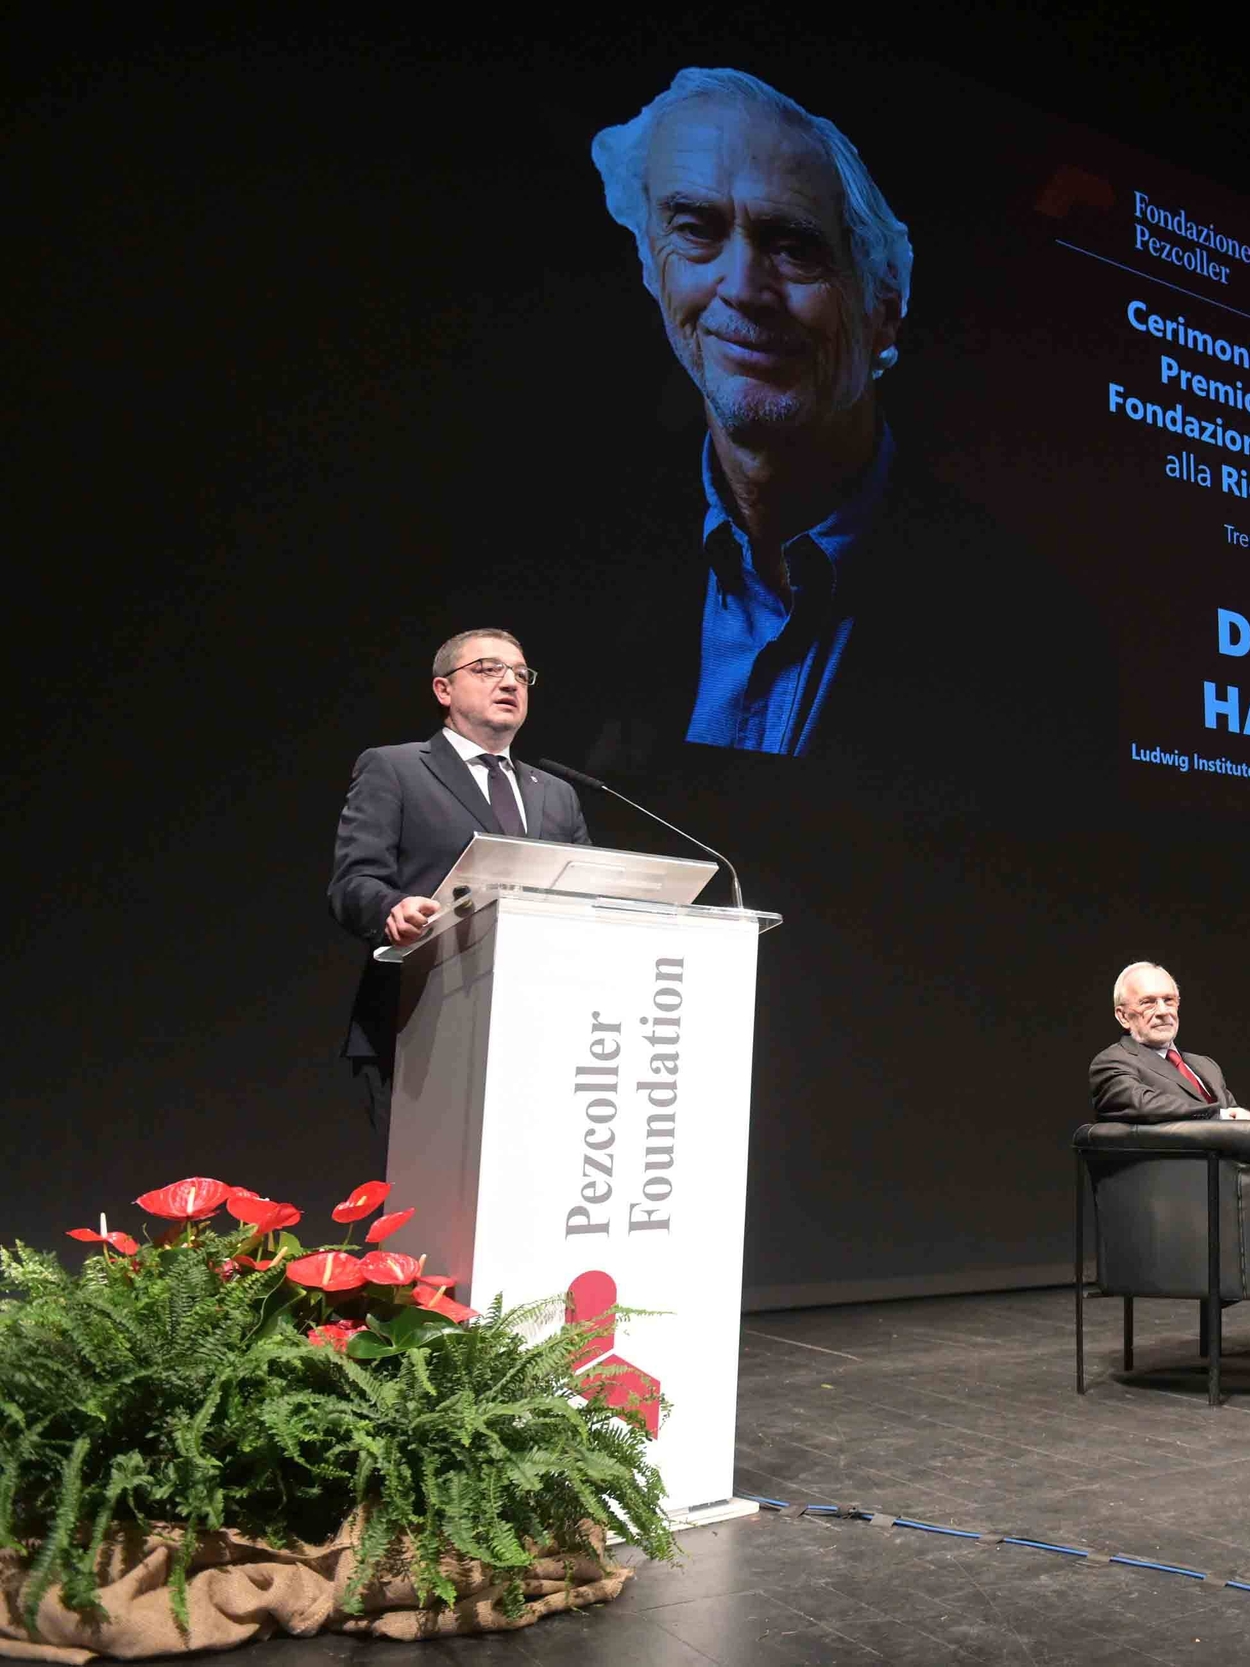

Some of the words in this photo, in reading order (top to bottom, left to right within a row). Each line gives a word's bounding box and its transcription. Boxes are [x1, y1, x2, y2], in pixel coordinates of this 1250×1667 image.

[1135, 224, 1230, 284] Pezcoller
[1165, 452, 1211, 487] alla
[1131, 743, 1189, 772] Ludwig
[565, 1011, 623, 1240] Pezcoller
[629, 956, 685, 1236] Foundation
